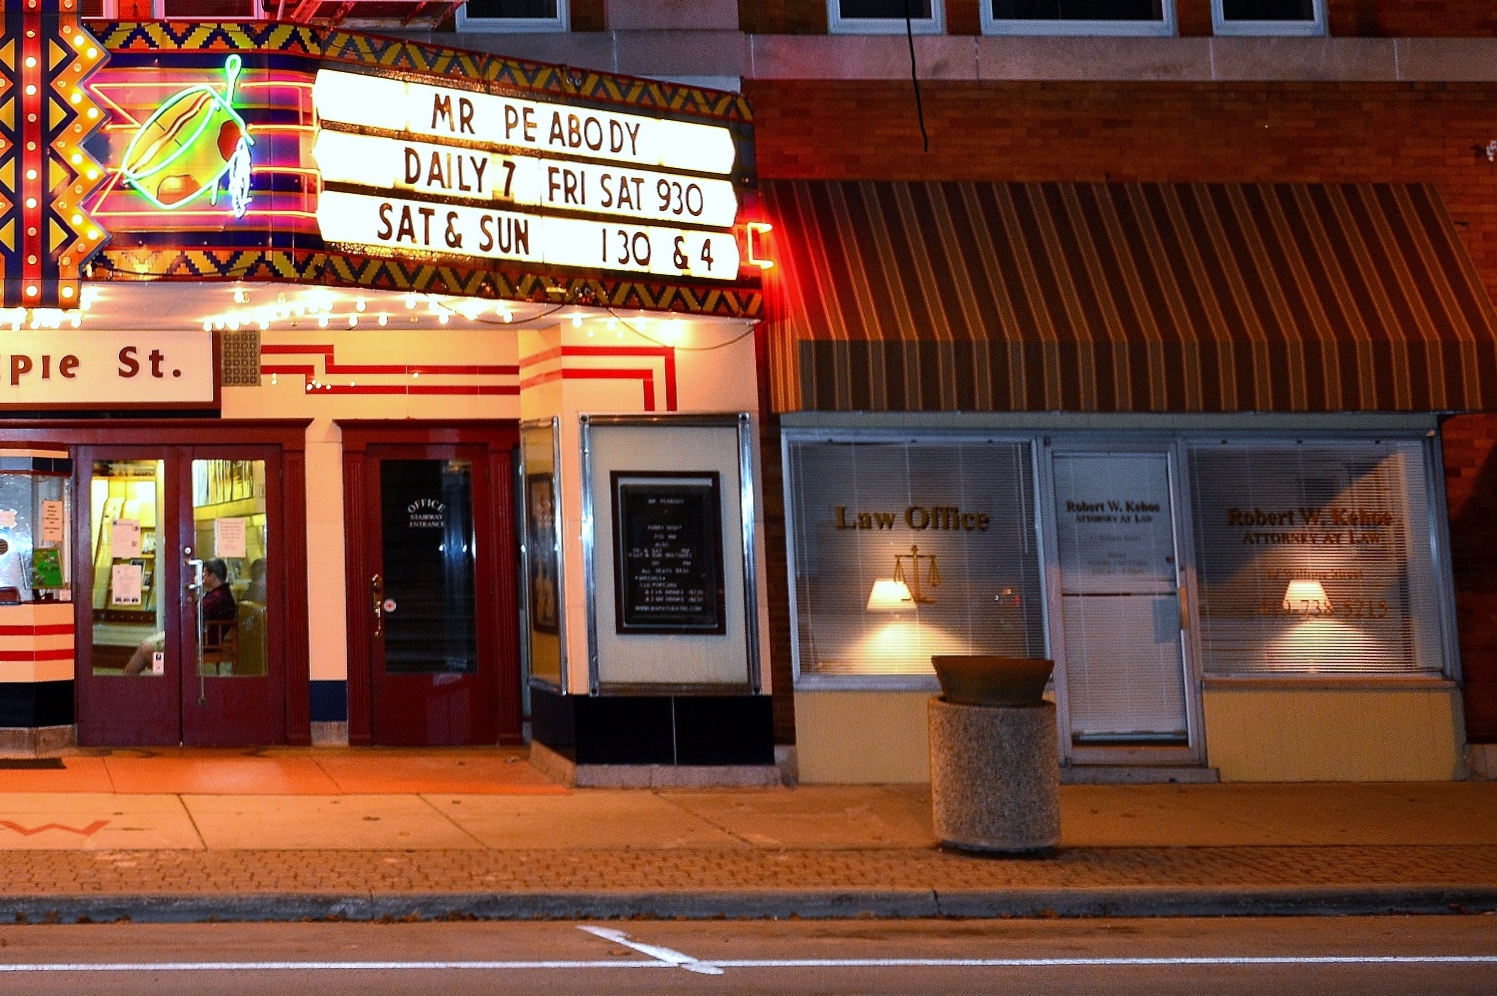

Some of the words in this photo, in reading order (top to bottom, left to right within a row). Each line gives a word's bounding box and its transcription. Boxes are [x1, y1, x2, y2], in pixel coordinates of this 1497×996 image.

[431, 93, 476, 136] MR
[504, 106, 641, 156] PEABODY
[404, 147, 488, 194] DAILY
[502, 161, 516, 198] 7
[547, 165, 587, 205] FRI
[600, 173, 645, 212] SAT
[657, 178, 704, 217] 930
[376, 202, 435, 243] SAT
[444, 216, 463, 249] &
[479, 214, 530, 256] SUN
[601, 227, 651, 267] 130
[672, 235, 692, 270] &
[699, 238, 715, 272] 4
[117, 345, 183, 379] St.
[407, 498, 446, 513] OFFICE
[835, 505, 896, 530] Law
[905, 505, 990, 531] Office
[1066, 500, 1104, 513] Robert
[1227, 507, 1294, 526] Robert
[1297, 507, 1325, 526] W.
